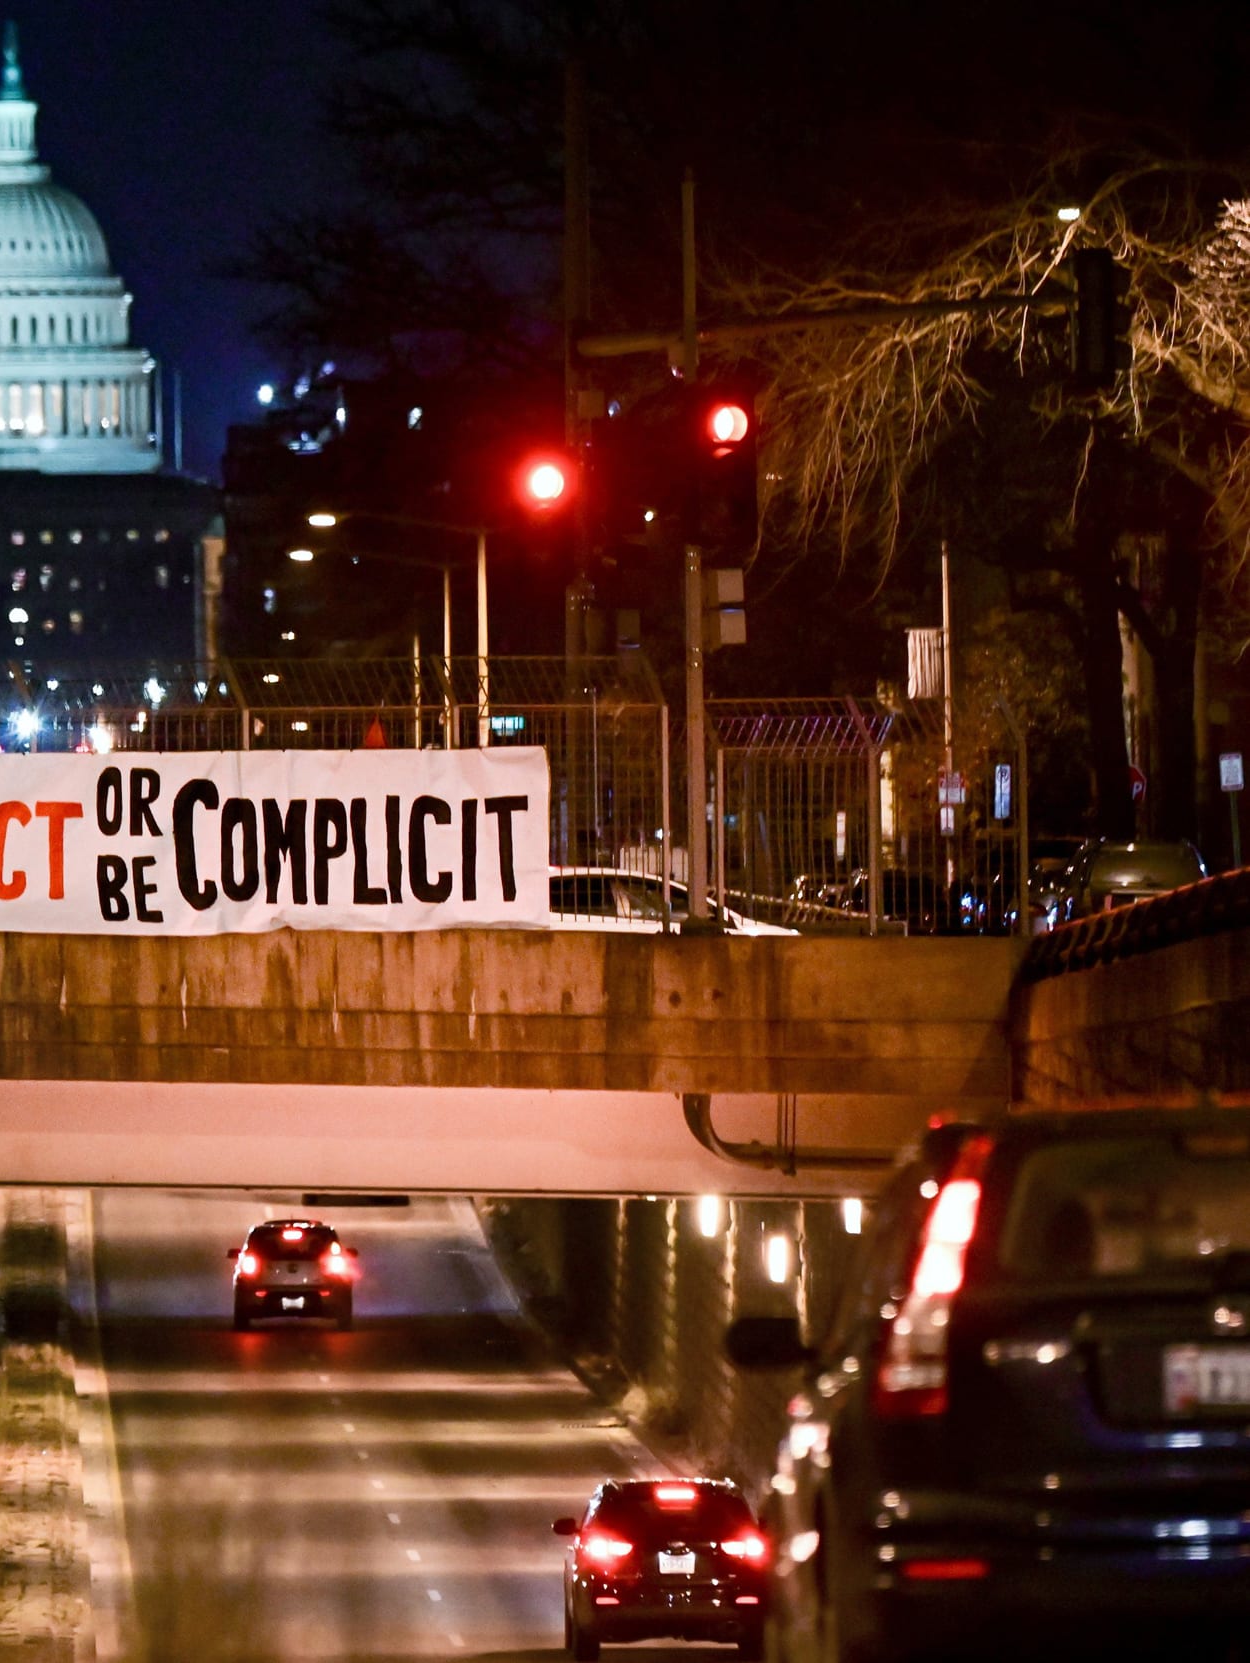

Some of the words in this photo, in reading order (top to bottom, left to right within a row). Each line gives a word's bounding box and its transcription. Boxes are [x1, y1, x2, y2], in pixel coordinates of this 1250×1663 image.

[96, 766, 164, 837] OR
[172, 778, 529, 911] COMPLICIT
[96, 854, 164, 923] BE
